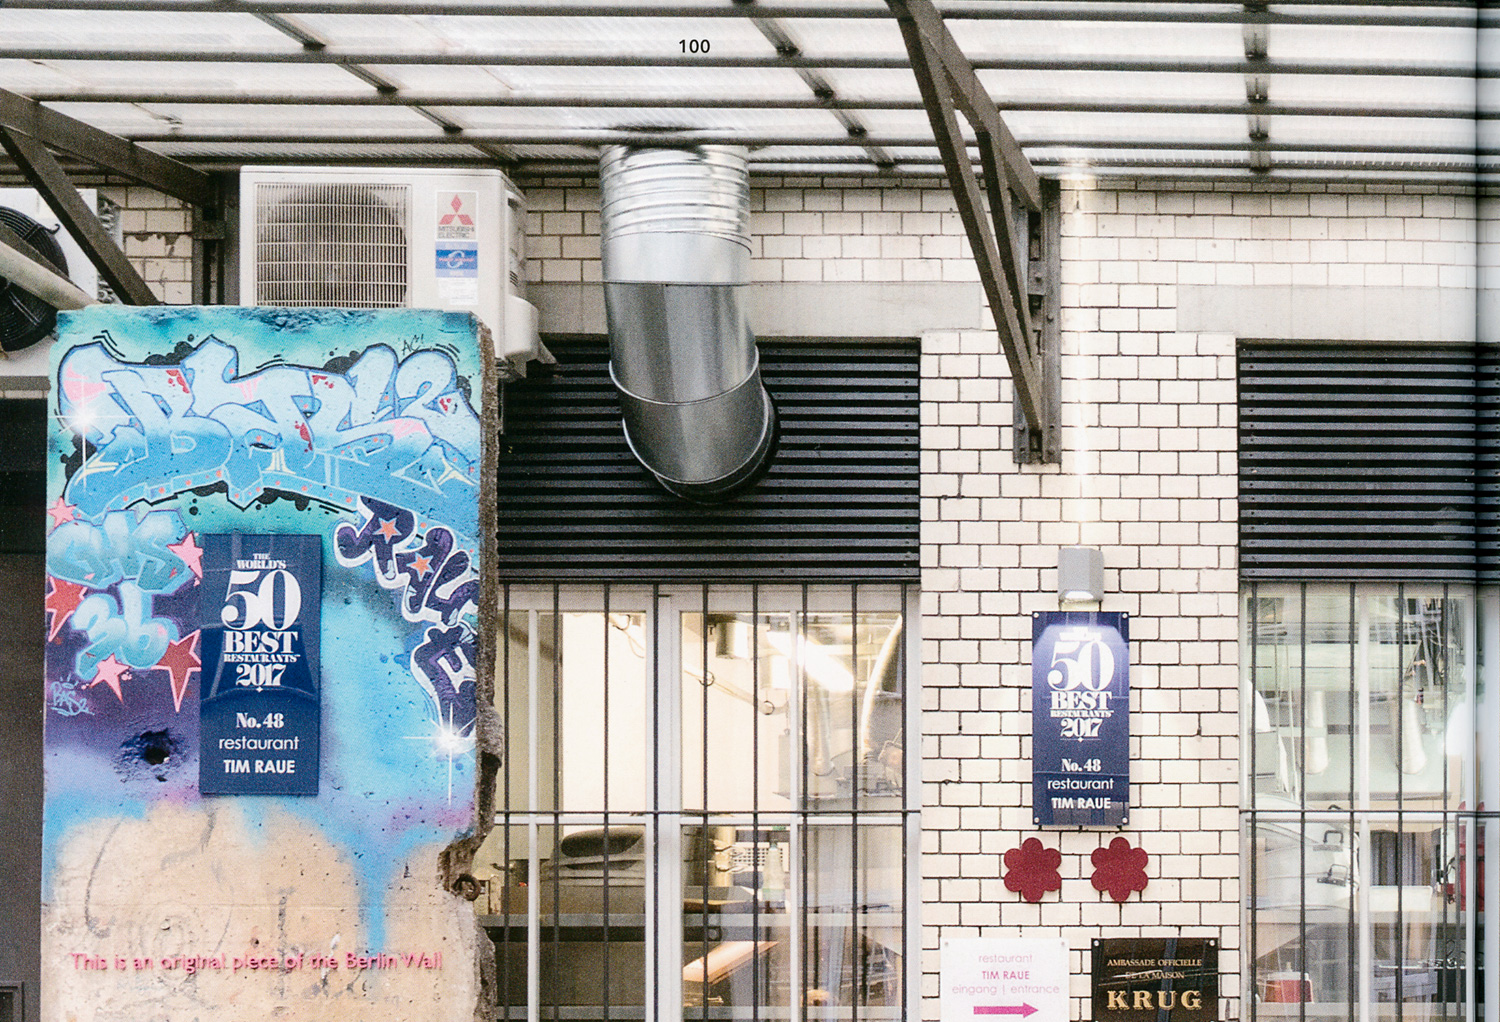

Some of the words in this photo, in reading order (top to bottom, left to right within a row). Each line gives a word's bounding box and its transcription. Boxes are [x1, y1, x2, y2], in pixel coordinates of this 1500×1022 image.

[236, 560, 287, 569] WORLD'S
[221, 569, 301, 631] 50
[223, 631, 298, 653] BEST
[1047, 641, 1114, 691] 50
[235, 663, 287, 686] 2017
[1050, 691, 1112, 709] BEST
[1060, 718, 1103, 737] 2017
[219, 736, 299, 750] restaurant
[223, 759, 250, 773] TIM
[254, 759, 295, 773] RAUE
[1047, 778, 1114, 790] restaurant
[1051, 797, 1074, 809] TIM
[1077, 797, 1111, 809] RAUE
[71, 952, 107, 970] This
[114, 954, 126, 970] is
[133, 957, 153, 970] an
[161, 953, 225, 974] original
[232, 953, 279, 973] piece
[284, 952, 304, 970] of
[310, 952, 338, 969] the
[346, 951, 397, 969] Berlin
[401, 951, 443, 969] Wall
[979, 954, 1033, 963] restaurant
[1107, 958, 1156, 967] AMBASSADE
[1157, 958, 1202, 967] OFFICIELLE
[982, 970, 1000, 980] TIM
[1003, 970, 1030, 980] RAUE
[1151, 971, 1185, 979] MAISON
[952, 984, 997, 996] eingang
[1011, 985, 1060, 994] entrance
[1107, 990, 1202, 1010] KRUG
